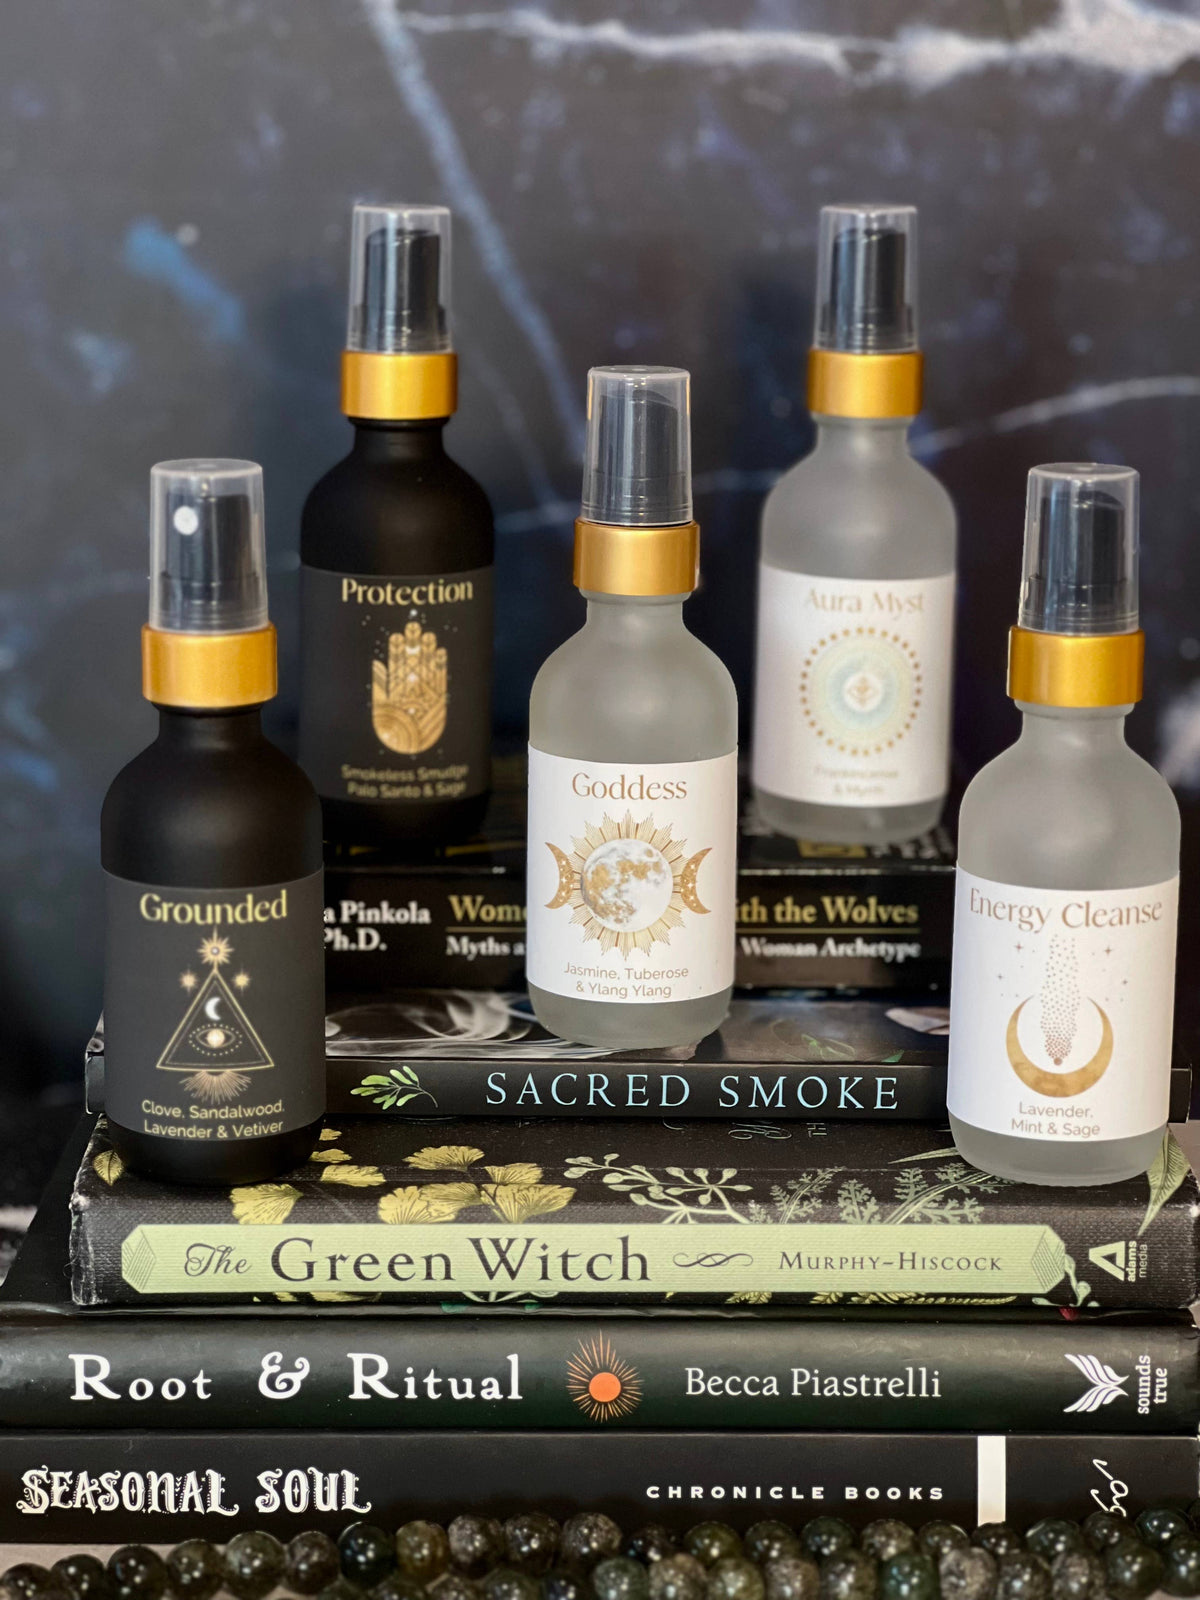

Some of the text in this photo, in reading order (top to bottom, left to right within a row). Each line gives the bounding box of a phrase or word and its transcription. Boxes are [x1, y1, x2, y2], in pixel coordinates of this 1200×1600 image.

[342, 577, 473, 606] Protection
[803, 588, 925, 621] Aura Myst
[572, 772, 688, 801] Goddess
[139, 889, 287, 926] Grounded
[340, 901, 431, 924] Pinkola
[774, 896, 817, 923] the
[821, 896, 919, 923] Wolves
[970, 887, 1163, 934] Energy Cleanse
[446, 935, 510, 961] Myths
[740, 937, 818, 957] Woman
[820, 937, 921, 963] Archetype
[576, 981, 672, 999] & Ylang Ylang
[624, 967, 689, 981] Tuberose
[486, 1072, 898, 1110] SACRED SMOKE
[144, 1120, 284, 1138] Lavender & Vetiver
[1011, 1118, 1101, 1139] Mint & Sage
[184, 1236, 650, 1282] The Green Witch
[1127, 1240, 1137, 1283] adams
[1138, 1244, 1148, 1279] media
[69, 1352, 523, 1401] Root & Ritual
[685, 1367, 942, 1398] Becca Piastrelli
[1136, 1354, 1150, 1415] sounds
[1152, 1367, 1168, 1404] true
[16, 1464, 372, 1515] SEASONAL SOUL
[646, 1486, 943, 1500] CHRONICLE BOOKS
